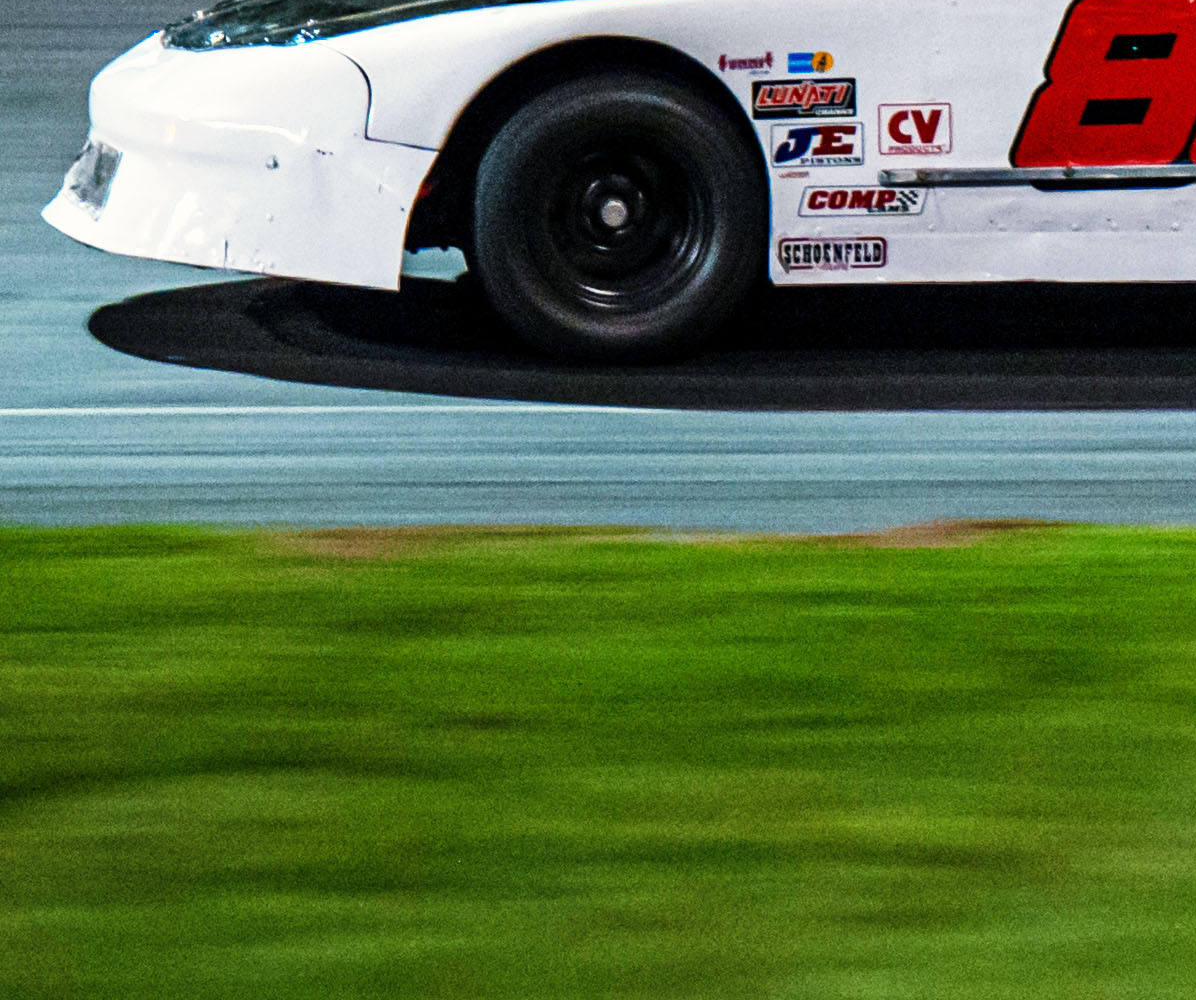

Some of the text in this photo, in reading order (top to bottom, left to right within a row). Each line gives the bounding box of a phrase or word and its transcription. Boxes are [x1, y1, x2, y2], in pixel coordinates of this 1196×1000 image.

[757, 81, 849, 109] LUNATI
[888, 110, 942, 144] CV
[775, 125, 857, 163] JE
[808, 190, 897, 210] COMP
[784, 243, 882, 264] SCHOENFELD
